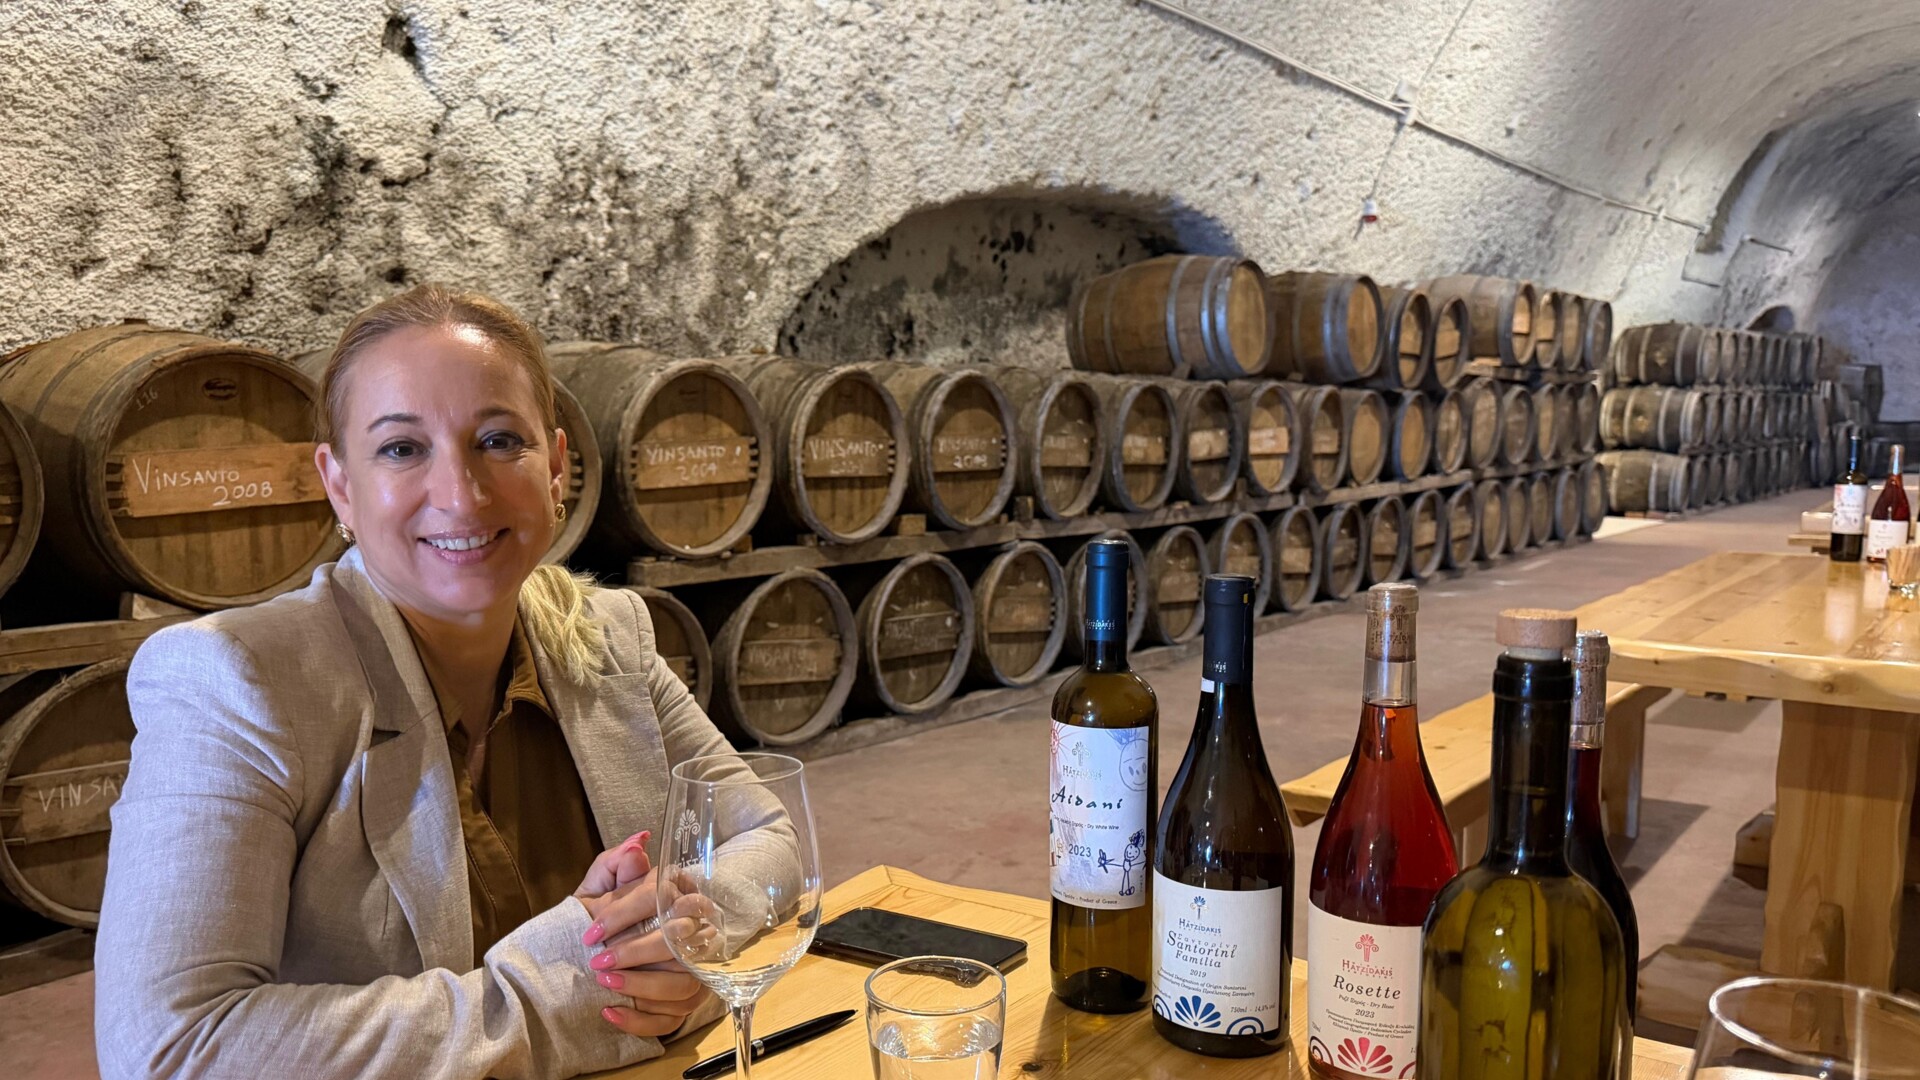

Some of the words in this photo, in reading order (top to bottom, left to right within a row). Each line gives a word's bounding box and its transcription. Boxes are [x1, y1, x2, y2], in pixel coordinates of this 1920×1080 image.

[212, 481, 273, 507] 2008
[1052, 785, 1123, 810] Aidani
[1068, 843, 1092, 858] 2023
[1167, 930, 1236, 959] Santorini
[1175, 950, 1222, 968] Familia
[1189, 969, 1207, 978] 2019
[1332, 974, 1401, 1000] Rosette
[1355, 1008, 1375, 1019] 2023
